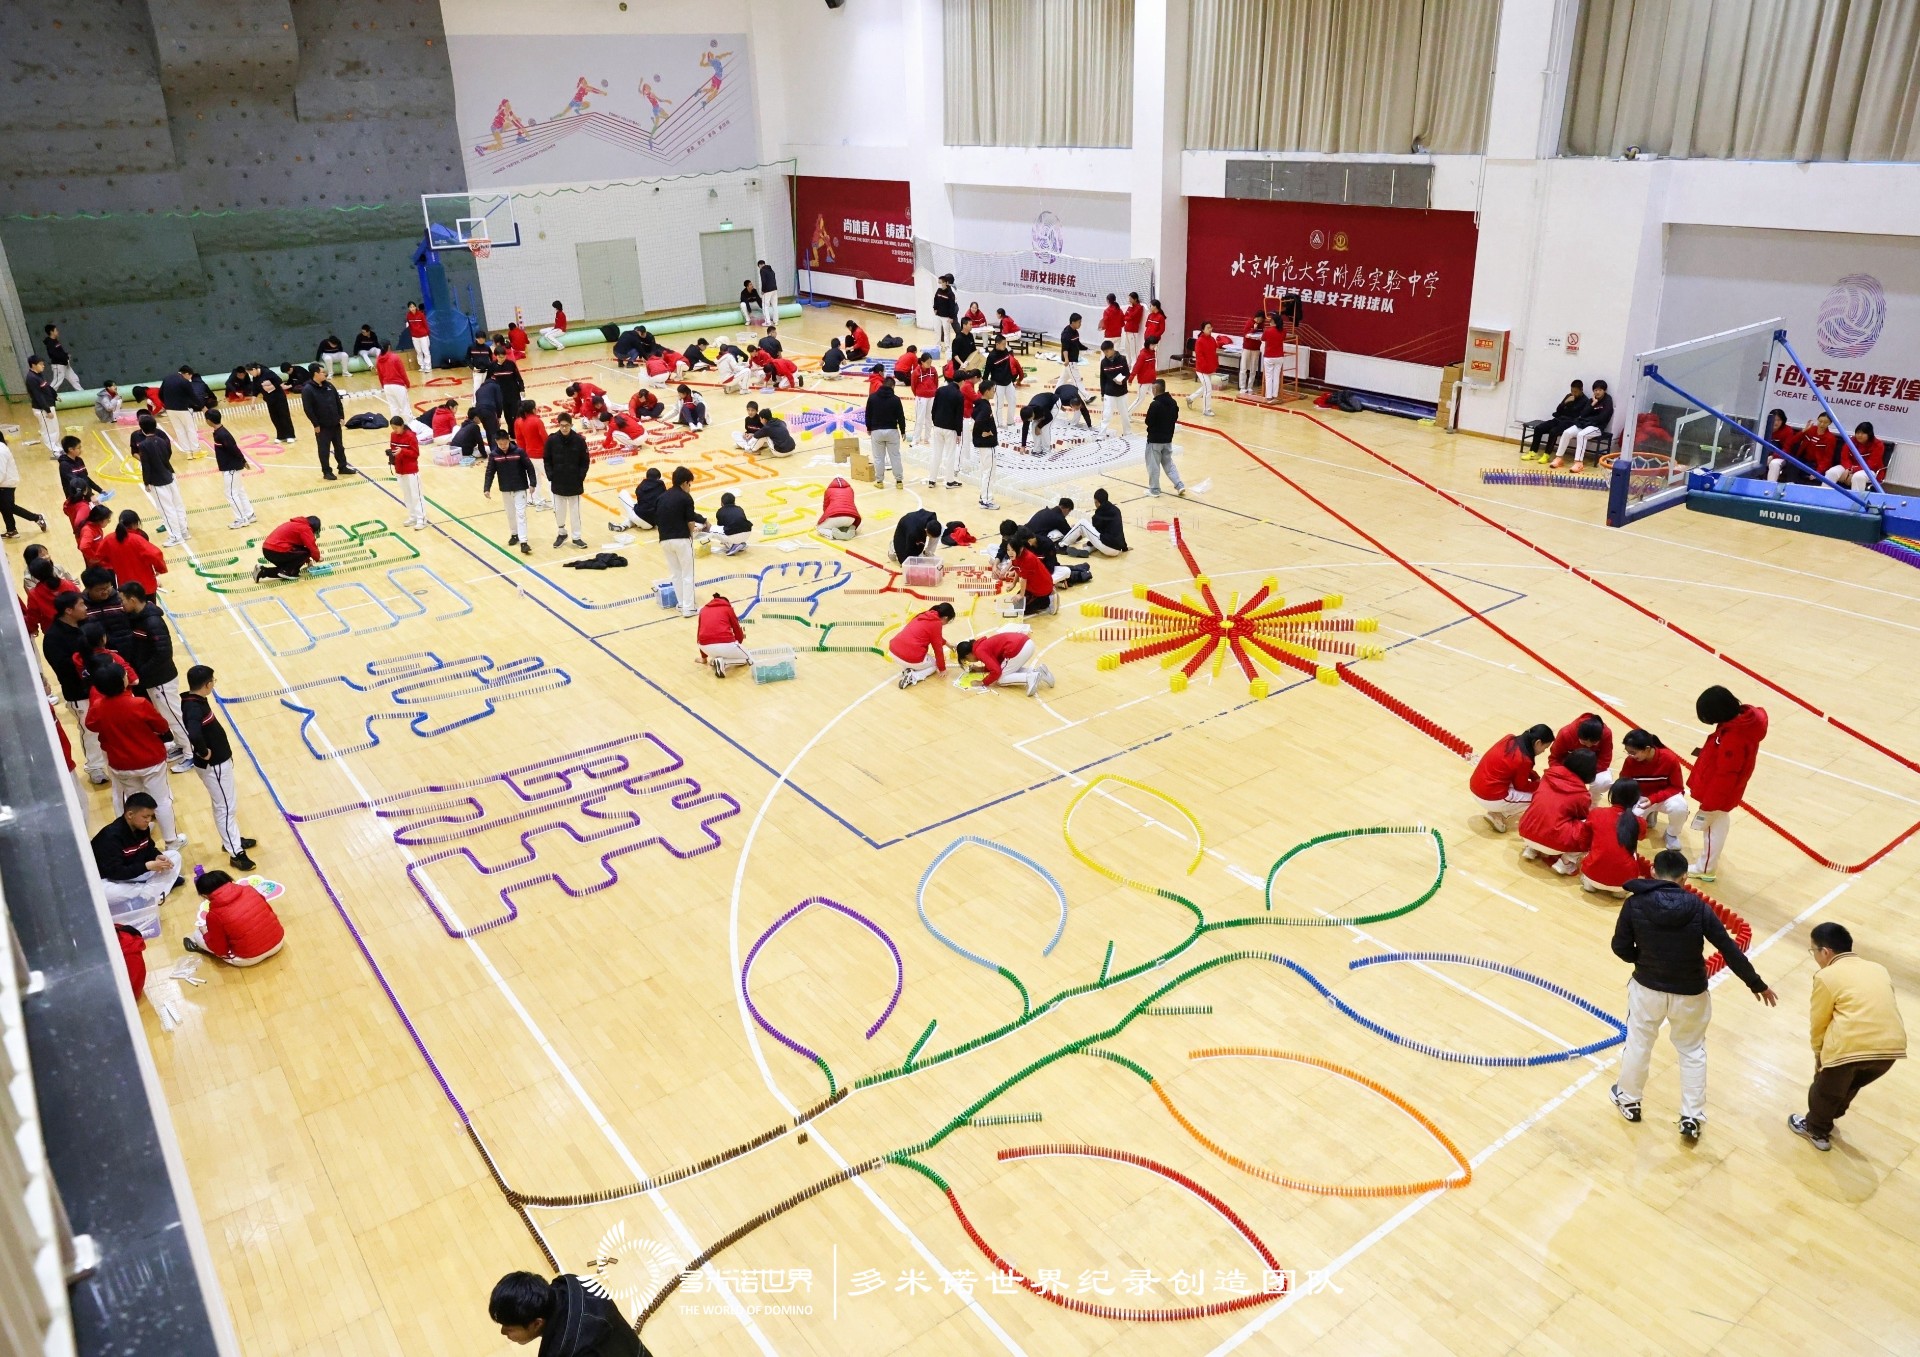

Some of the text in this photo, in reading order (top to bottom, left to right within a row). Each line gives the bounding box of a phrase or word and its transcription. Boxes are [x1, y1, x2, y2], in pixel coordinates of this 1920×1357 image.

[843, 218, 880, 237] 尚体育人
[1020, 268, 1076, 288] 继承女排传统
[1231, 252, 1440, 298] 北京师范大学附属实验中学
[1811, 394, 1862, 408] BILLIANCE
[1864, 401, 1876, 409] OF
[1878, 403, 1909, 414] ESBNU
[1759, 509, 1801, 523] MONDO
